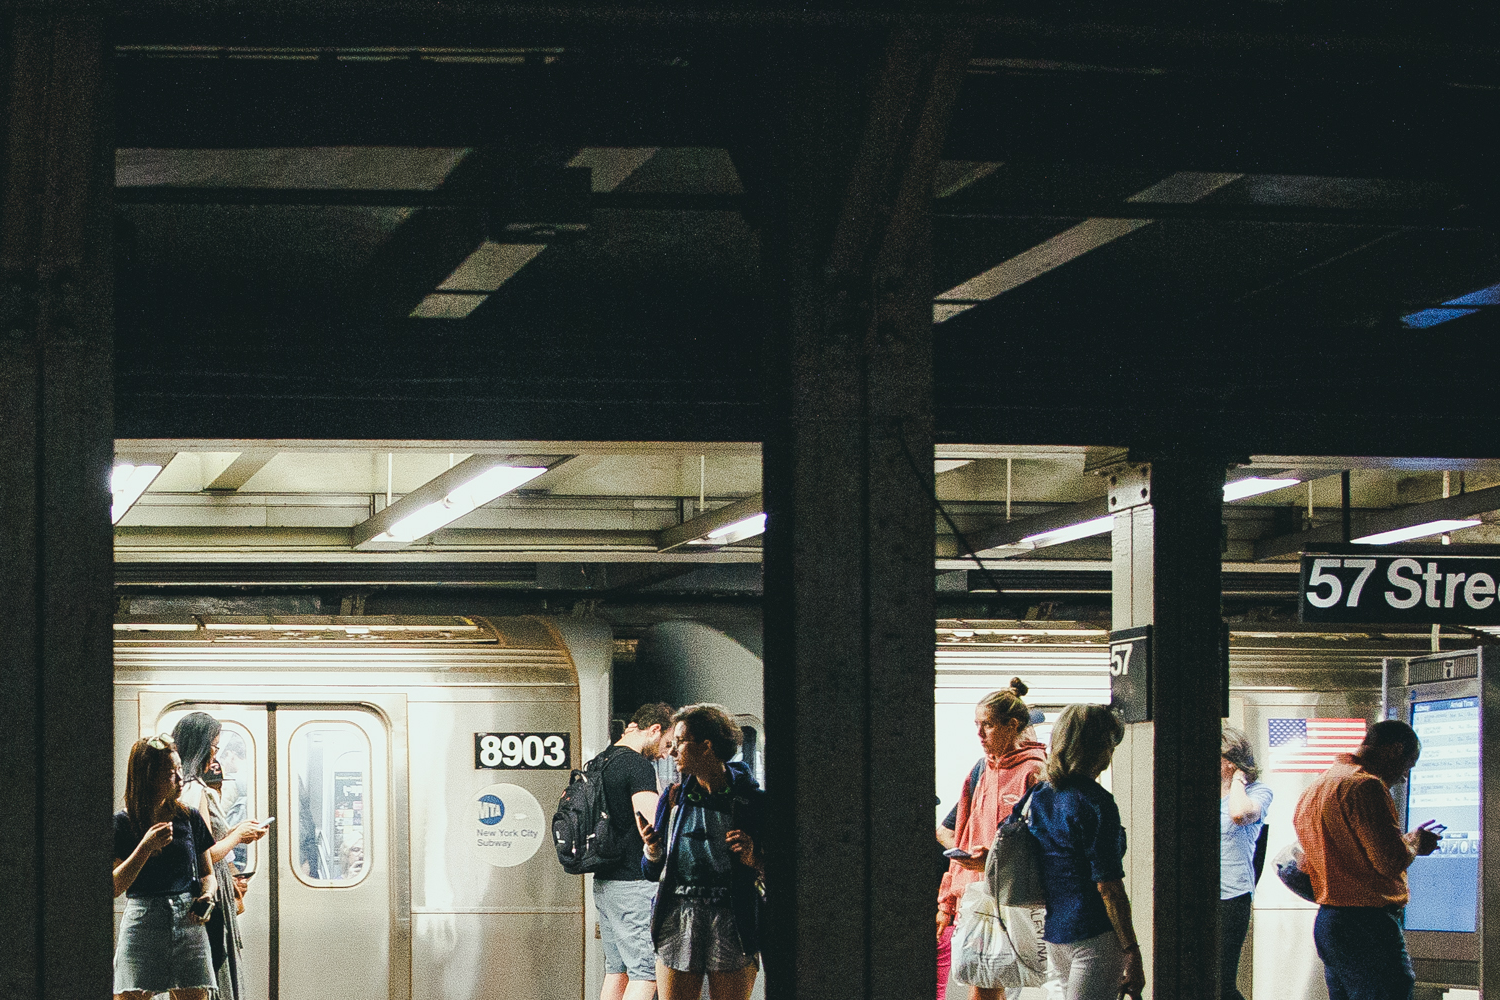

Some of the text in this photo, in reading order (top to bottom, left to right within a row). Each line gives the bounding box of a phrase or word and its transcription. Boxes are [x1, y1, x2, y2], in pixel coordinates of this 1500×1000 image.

[1306, 558, 1500, 609] 57 Stre
[1110, 643, 1133, 676] 57
[480, 735, 566, 766] 8903
[476, 829, 538, 838] New York City
[477, 839, 512, 848] Subway
